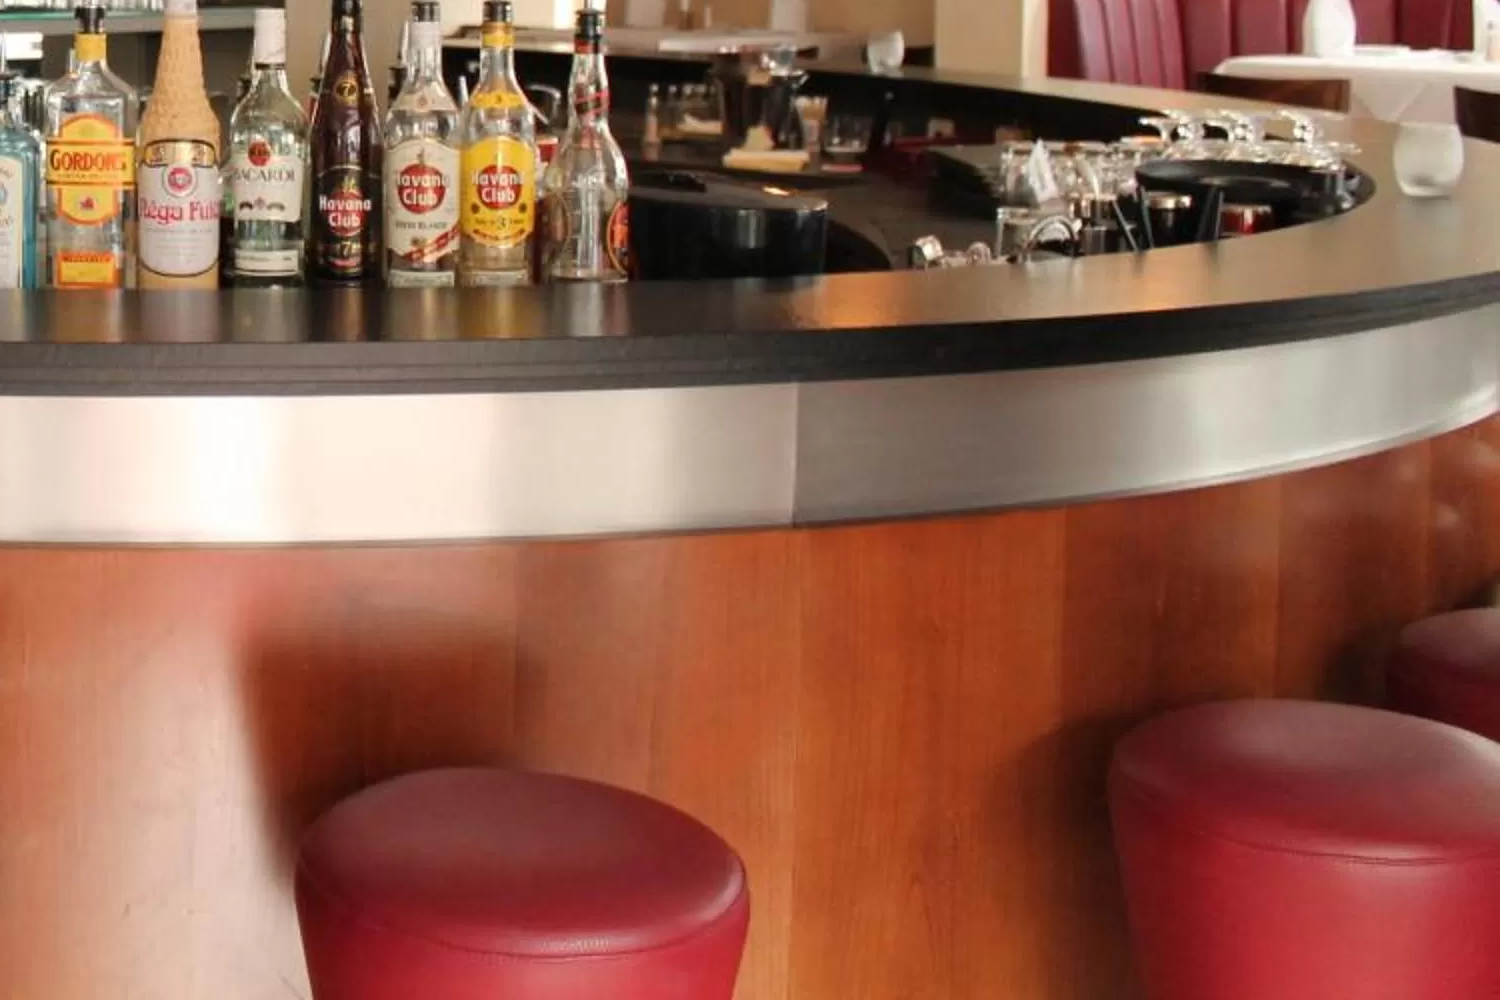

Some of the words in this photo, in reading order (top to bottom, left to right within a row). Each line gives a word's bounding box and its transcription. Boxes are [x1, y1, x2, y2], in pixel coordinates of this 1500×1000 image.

[319, 194, 372, 212] Havana
[403, 187, 438, 205] Club
[481, 185, 516, 203] Club
[329, 211, 361, 228] Club
